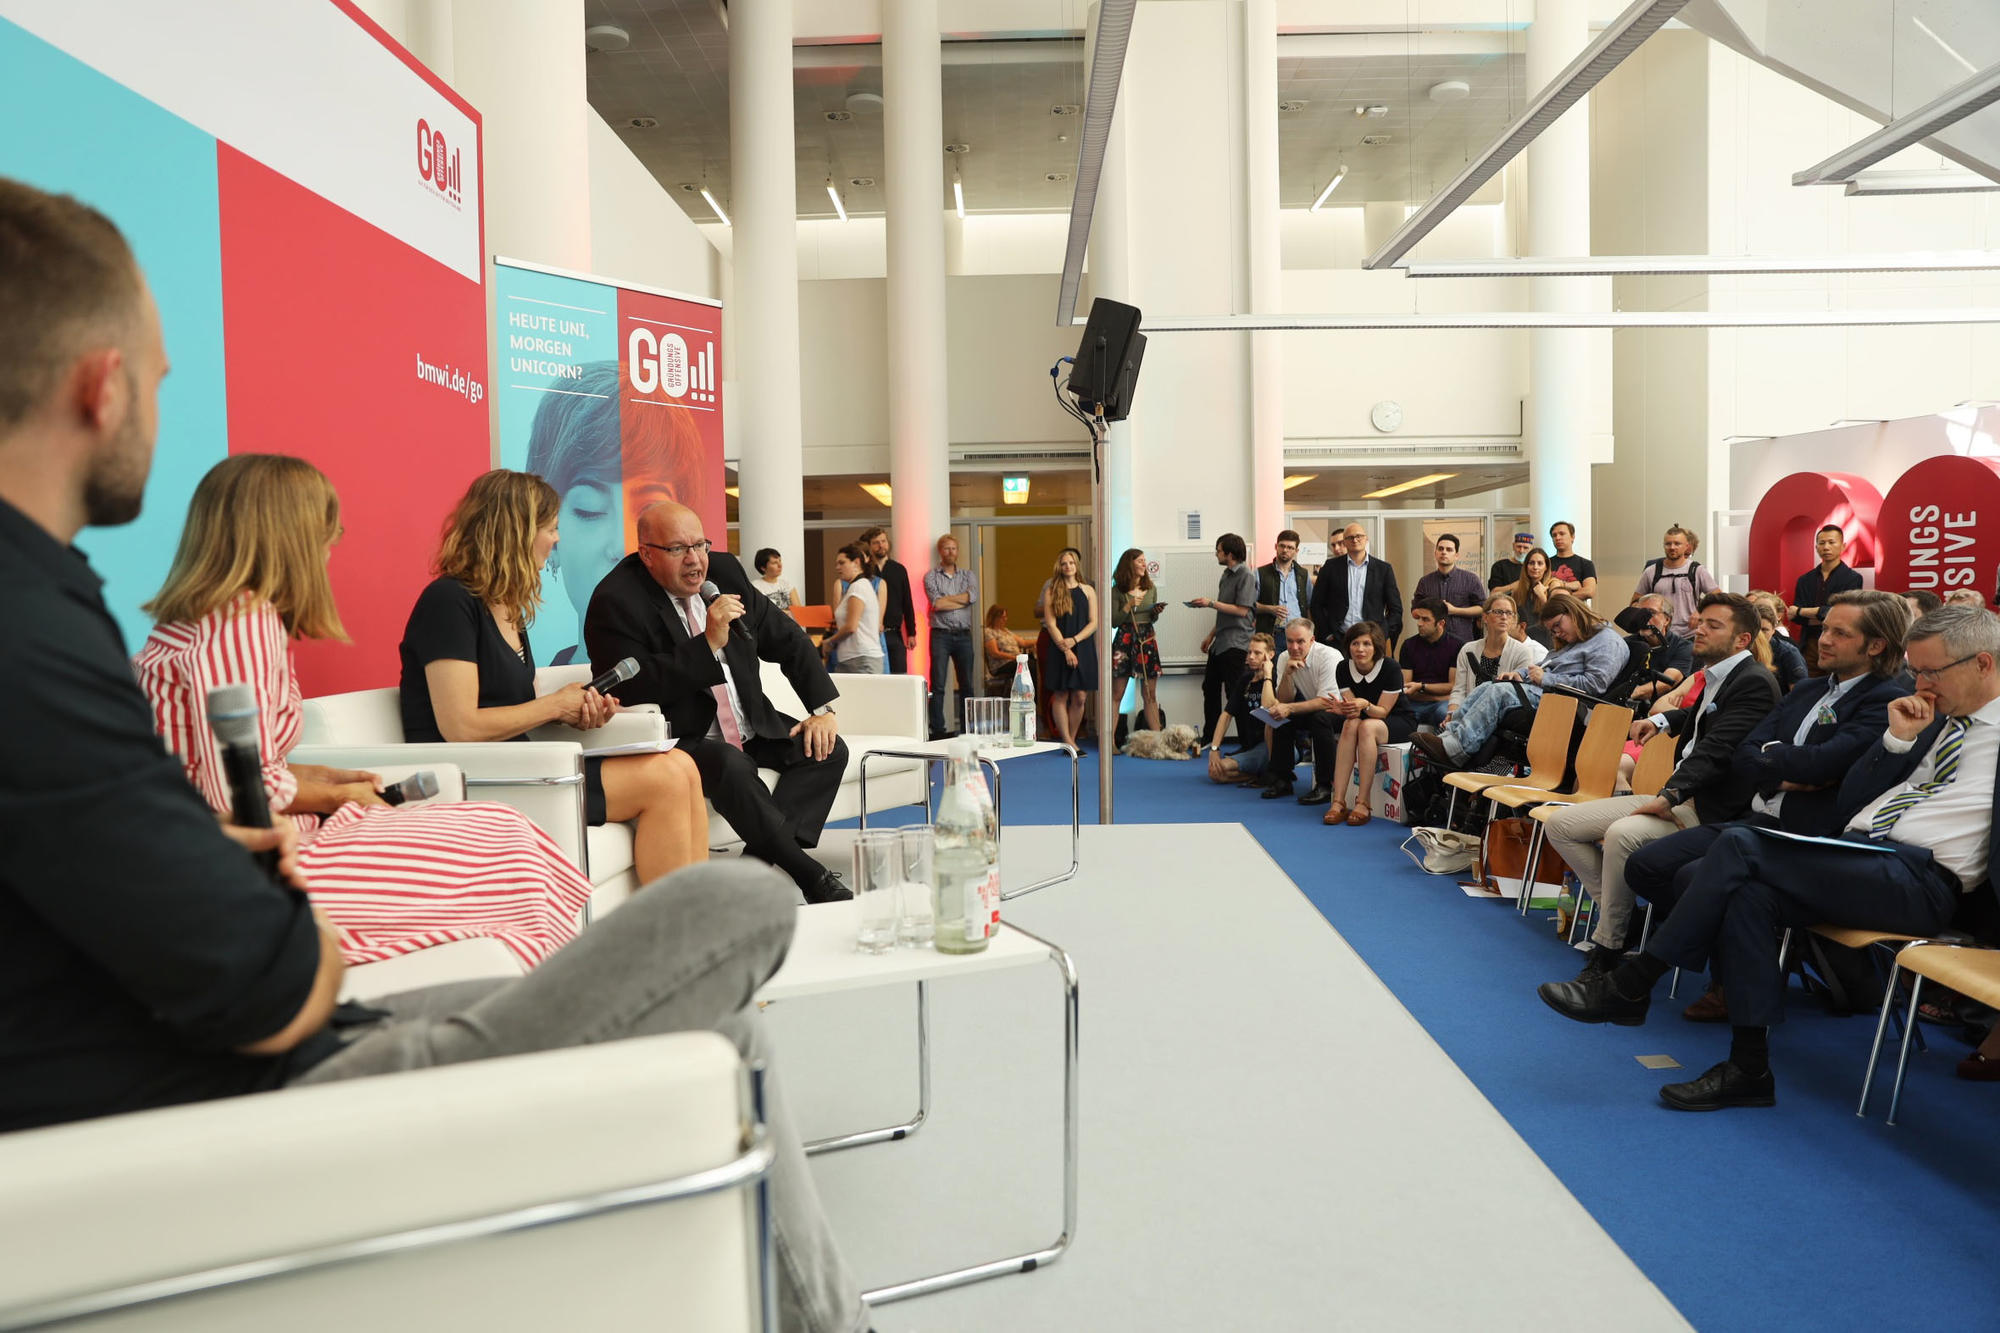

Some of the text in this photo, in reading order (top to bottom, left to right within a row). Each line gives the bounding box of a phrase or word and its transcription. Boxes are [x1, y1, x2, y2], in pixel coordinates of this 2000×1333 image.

[509, 311, 590, 340] HEUTE UNI,
[510, 334, 572, 357] MORGEN
[416, 352, 483, 404] bmwi.de/go
[511, 357, 583, 380] UNICORN?
[674, 346, 682, 387] OFFENSIVE
